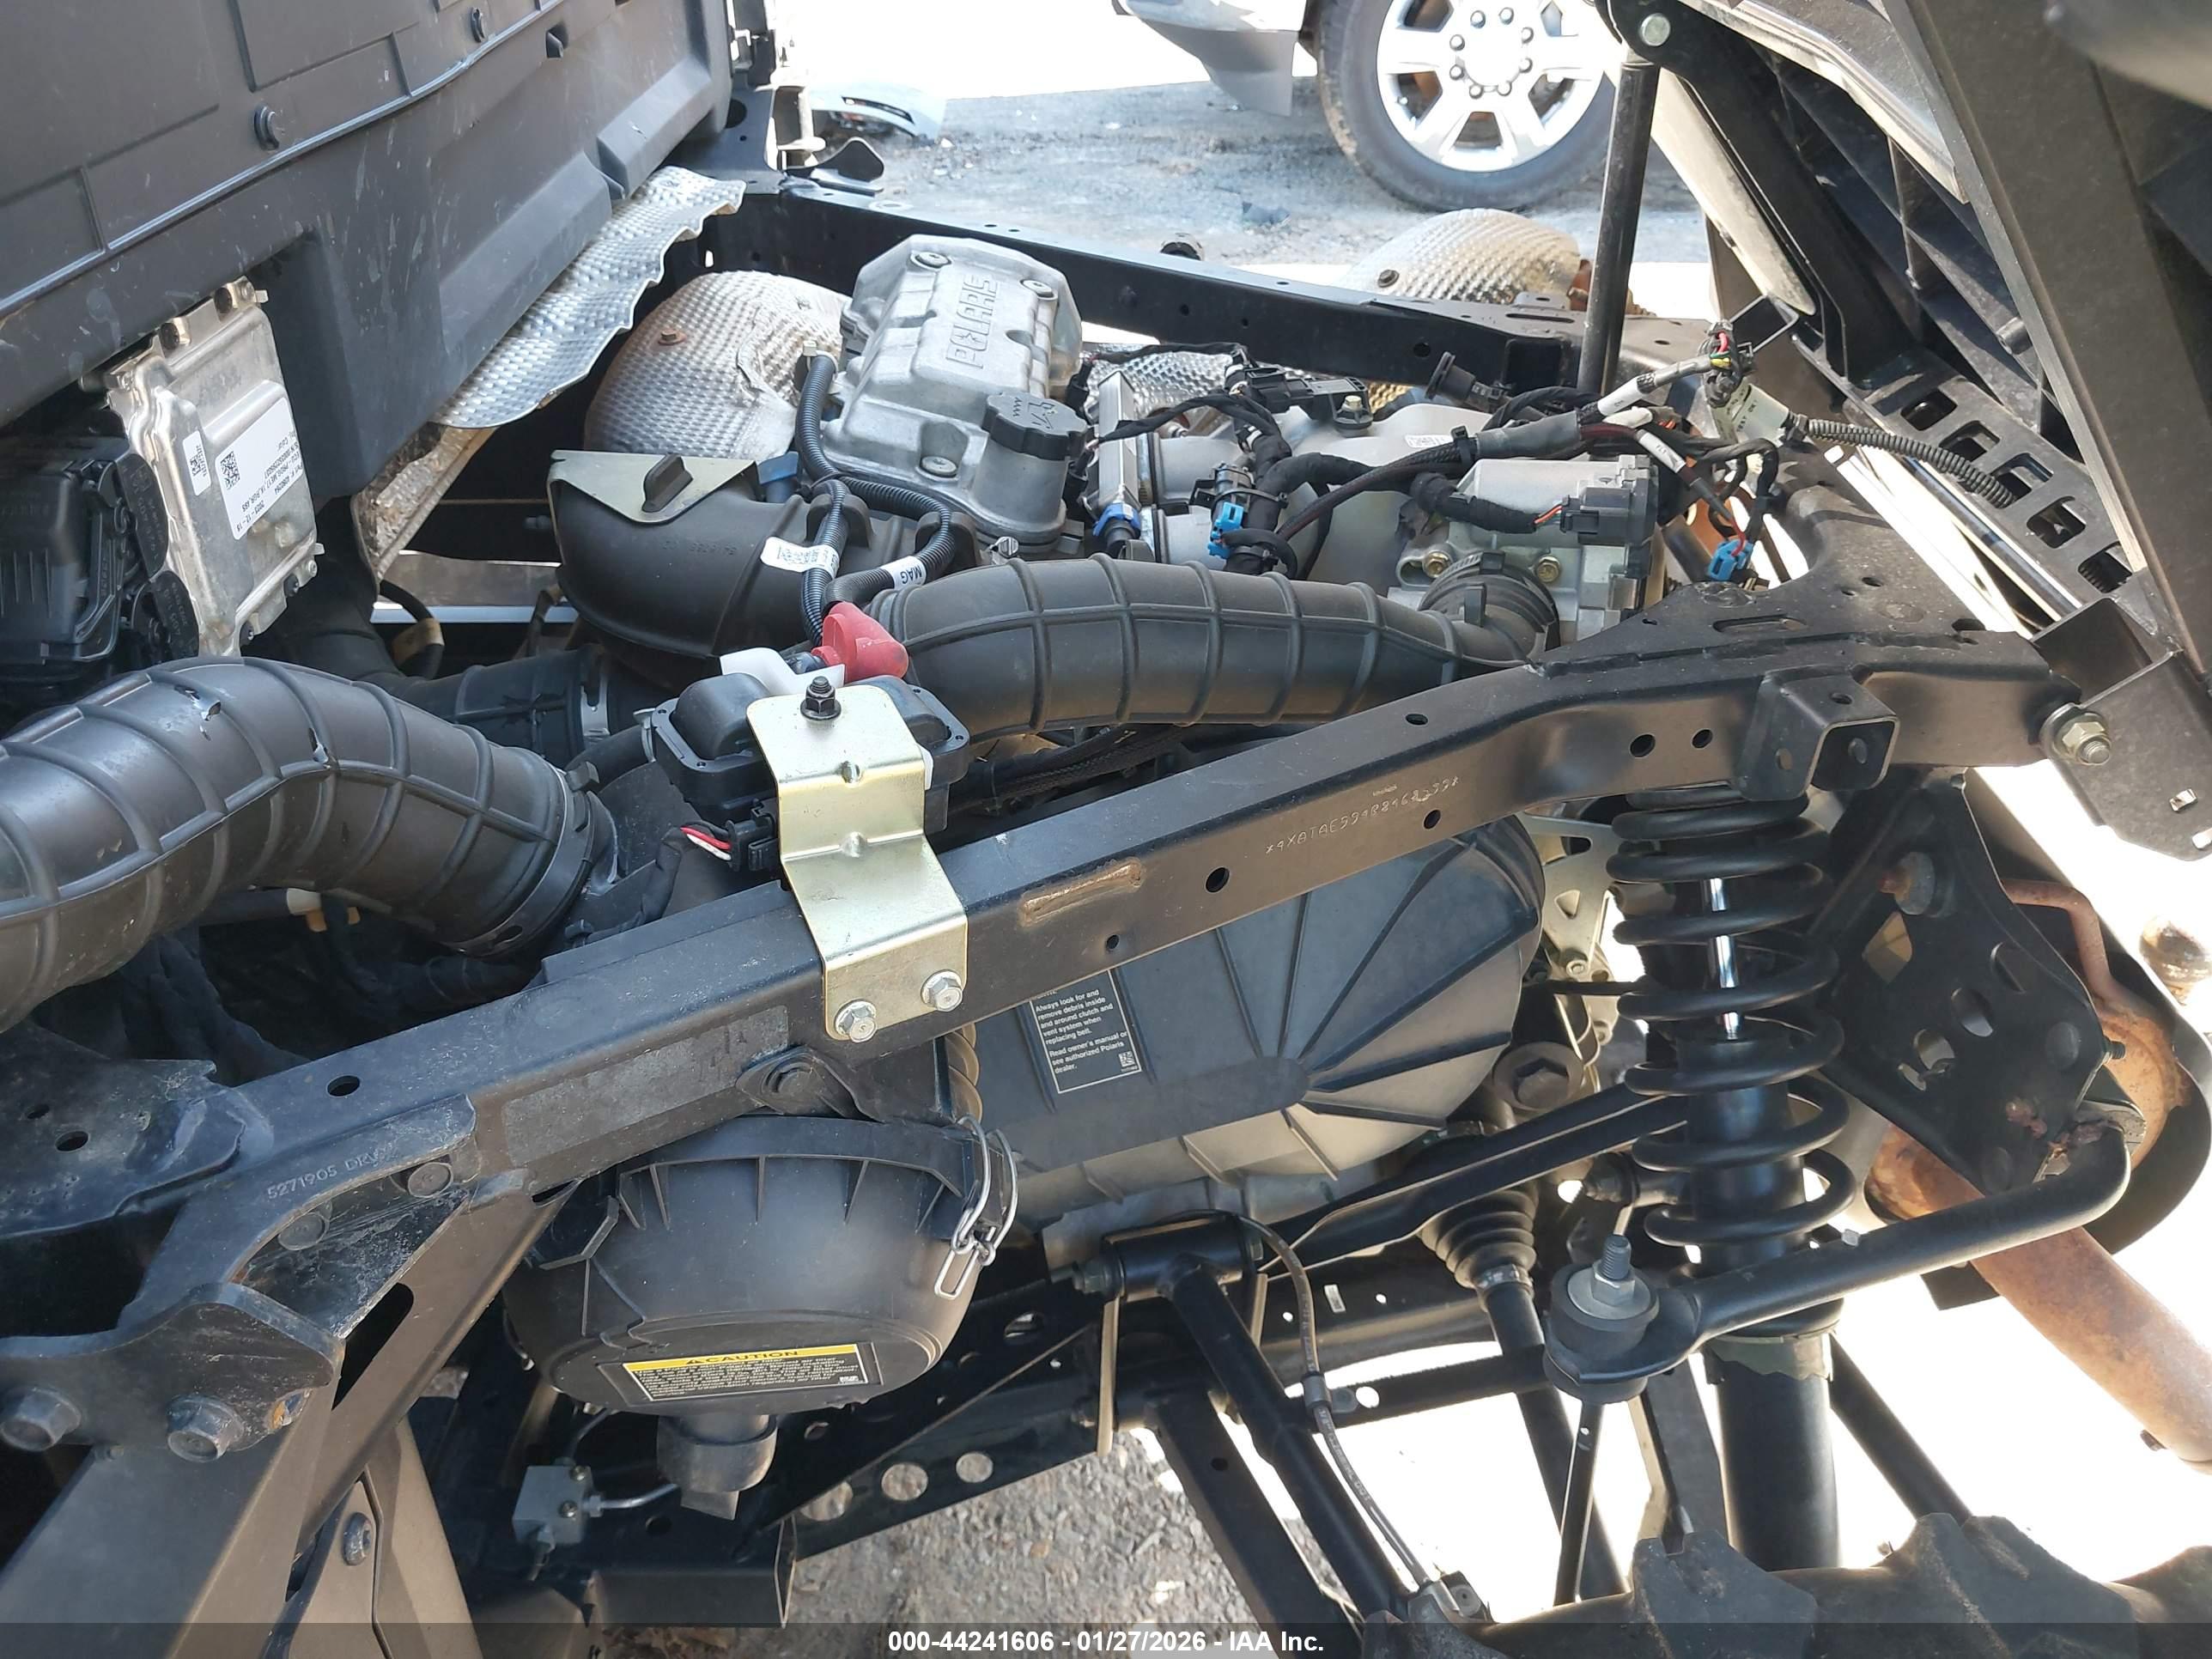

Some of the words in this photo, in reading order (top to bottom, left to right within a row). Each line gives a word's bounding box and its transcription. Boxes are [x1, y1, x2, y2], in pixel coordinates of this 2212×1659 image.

[900, 566, 923, 585] MAG
[1036, 1002, 1059, 1012] Always
[1060, 996, 1074, 1006] look
[1086, 989, 1099, 998] and
[1038, 1010, 1062, 1020] remove
[1063, 1004, 1085, 1013] debris
[1085, 997, 1106, 1006] inside
[1054, 1012, 1078, 1024] around
[1079, 1007, 1099, 1018] clutch
[1100, 1003, 1113, 1012] and
[1043, 1028, 1058, 1036] vent
[1059, 1021, 1083, 1033] system
[1084, 1016, 1102, 1025] when
[1046, 1032, 1076, 1045] replacing
[1049, 1047, 1066, 1057] Read
[1067, 1041, 1094, 1053] owner's
[1095, 1034, 1119, 1044] manual
[1065, 1048, 1100, 1062] authorized
[1101, 1040, 1124, 1052] Polaris
[1054, 1064, 1077, 1073] dealer.
[267, 1165, 337, 1199] 5271905
[704, 1351, 799, 1363] CAUTION
